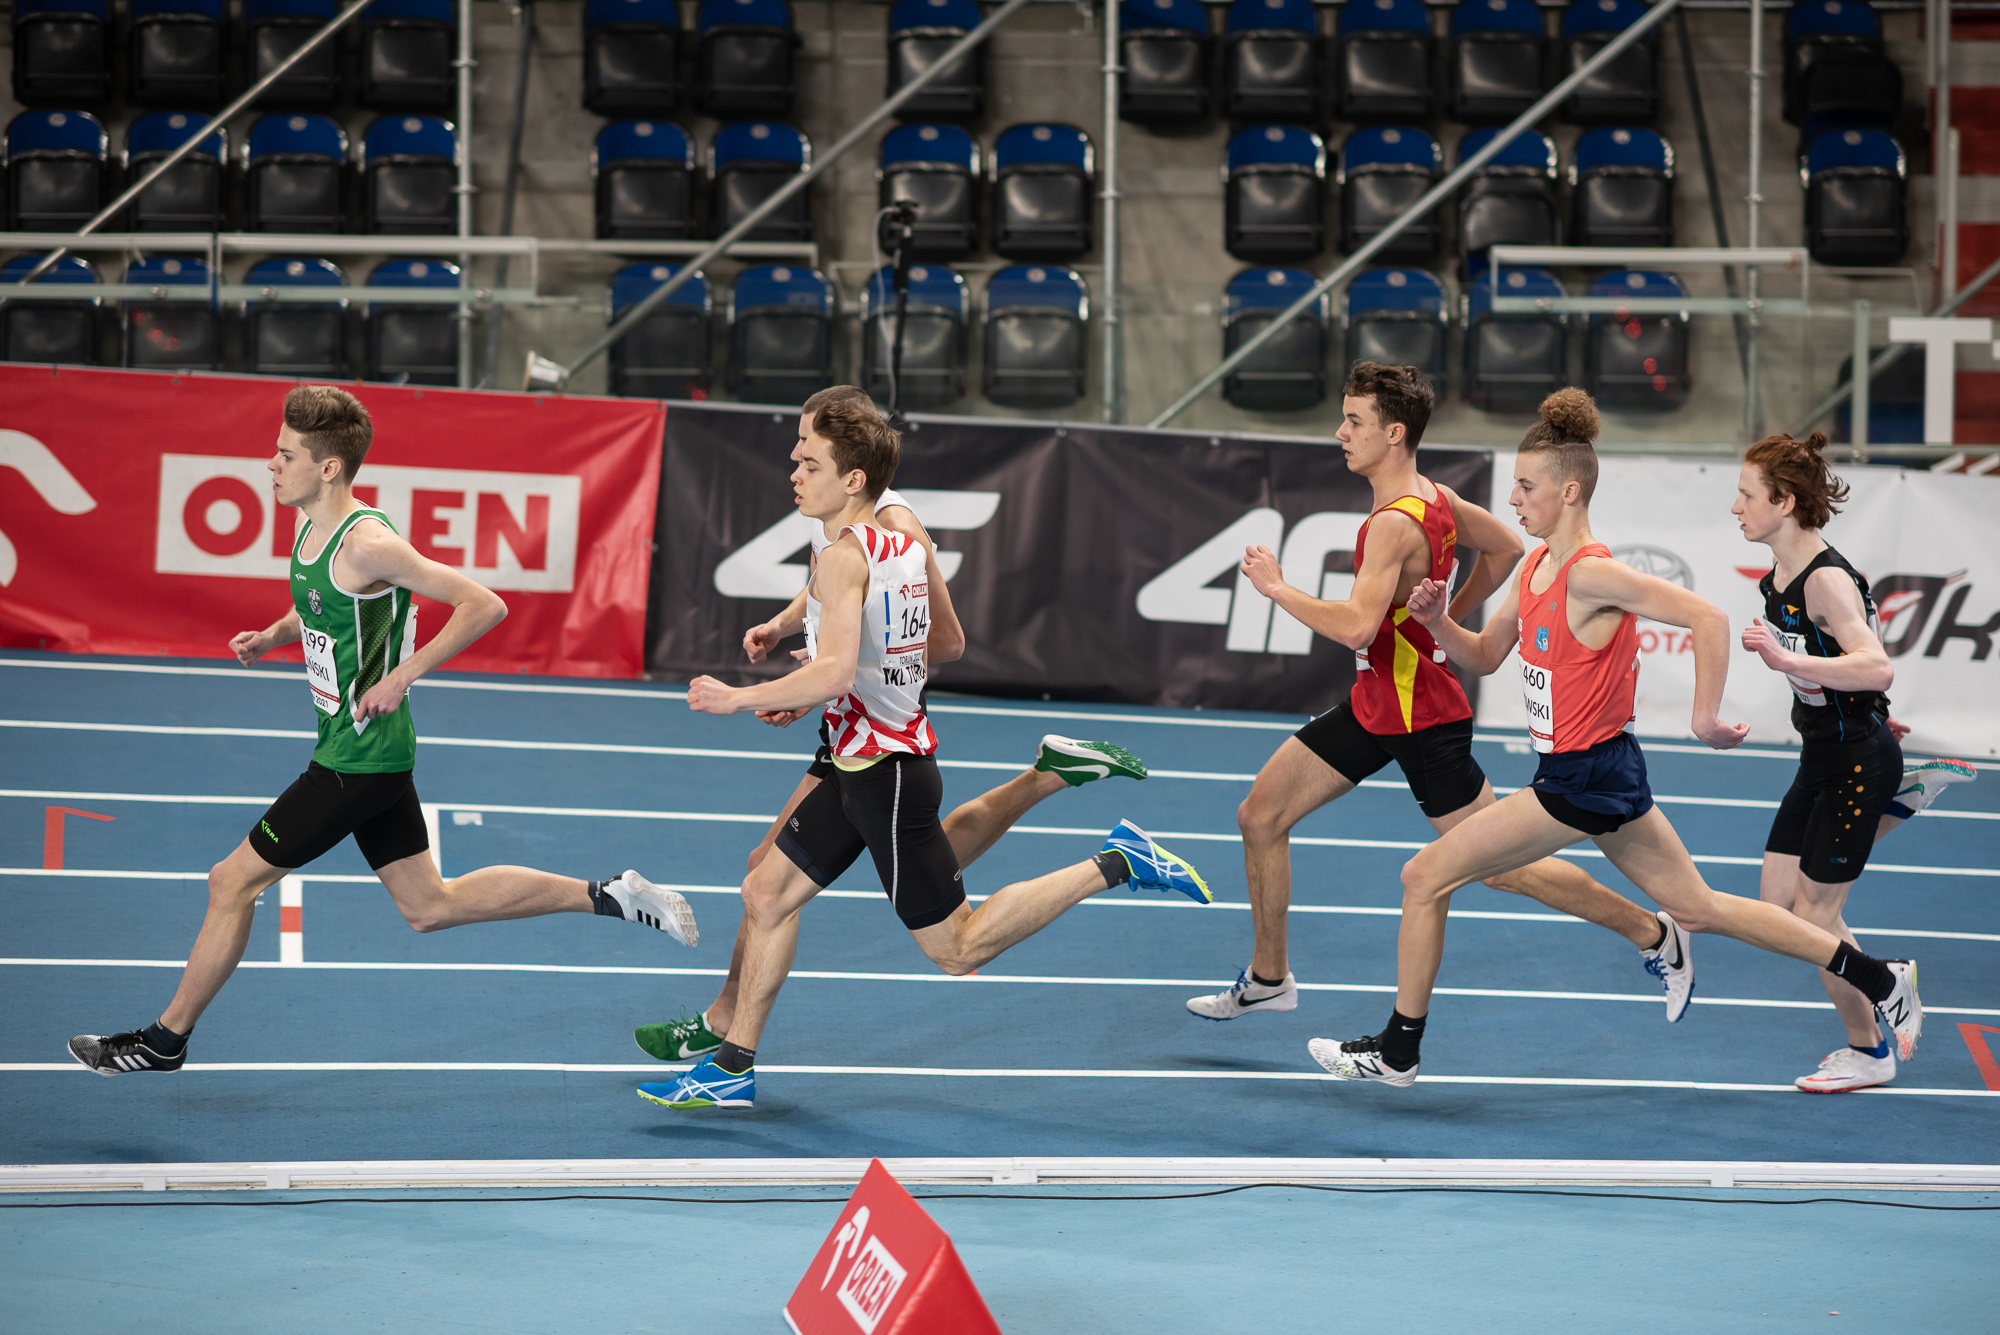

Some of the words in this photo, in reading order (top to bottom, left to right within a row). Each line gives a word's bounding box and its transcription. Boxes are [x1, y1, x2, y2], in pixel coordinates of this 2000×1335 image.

[1888, 316, 2000, 445] T
[183, 476, 551, 571] OEN
[901, 604, 927, 639] 164
[304, 628, 327, 653] 199
[1640, 630, 1694, 654] OTA
[1523, 665, 1545, 690] 460
[1523, 693, 1550, 720] WSKI
[846, 1249, 898, 1322] ORLEN
